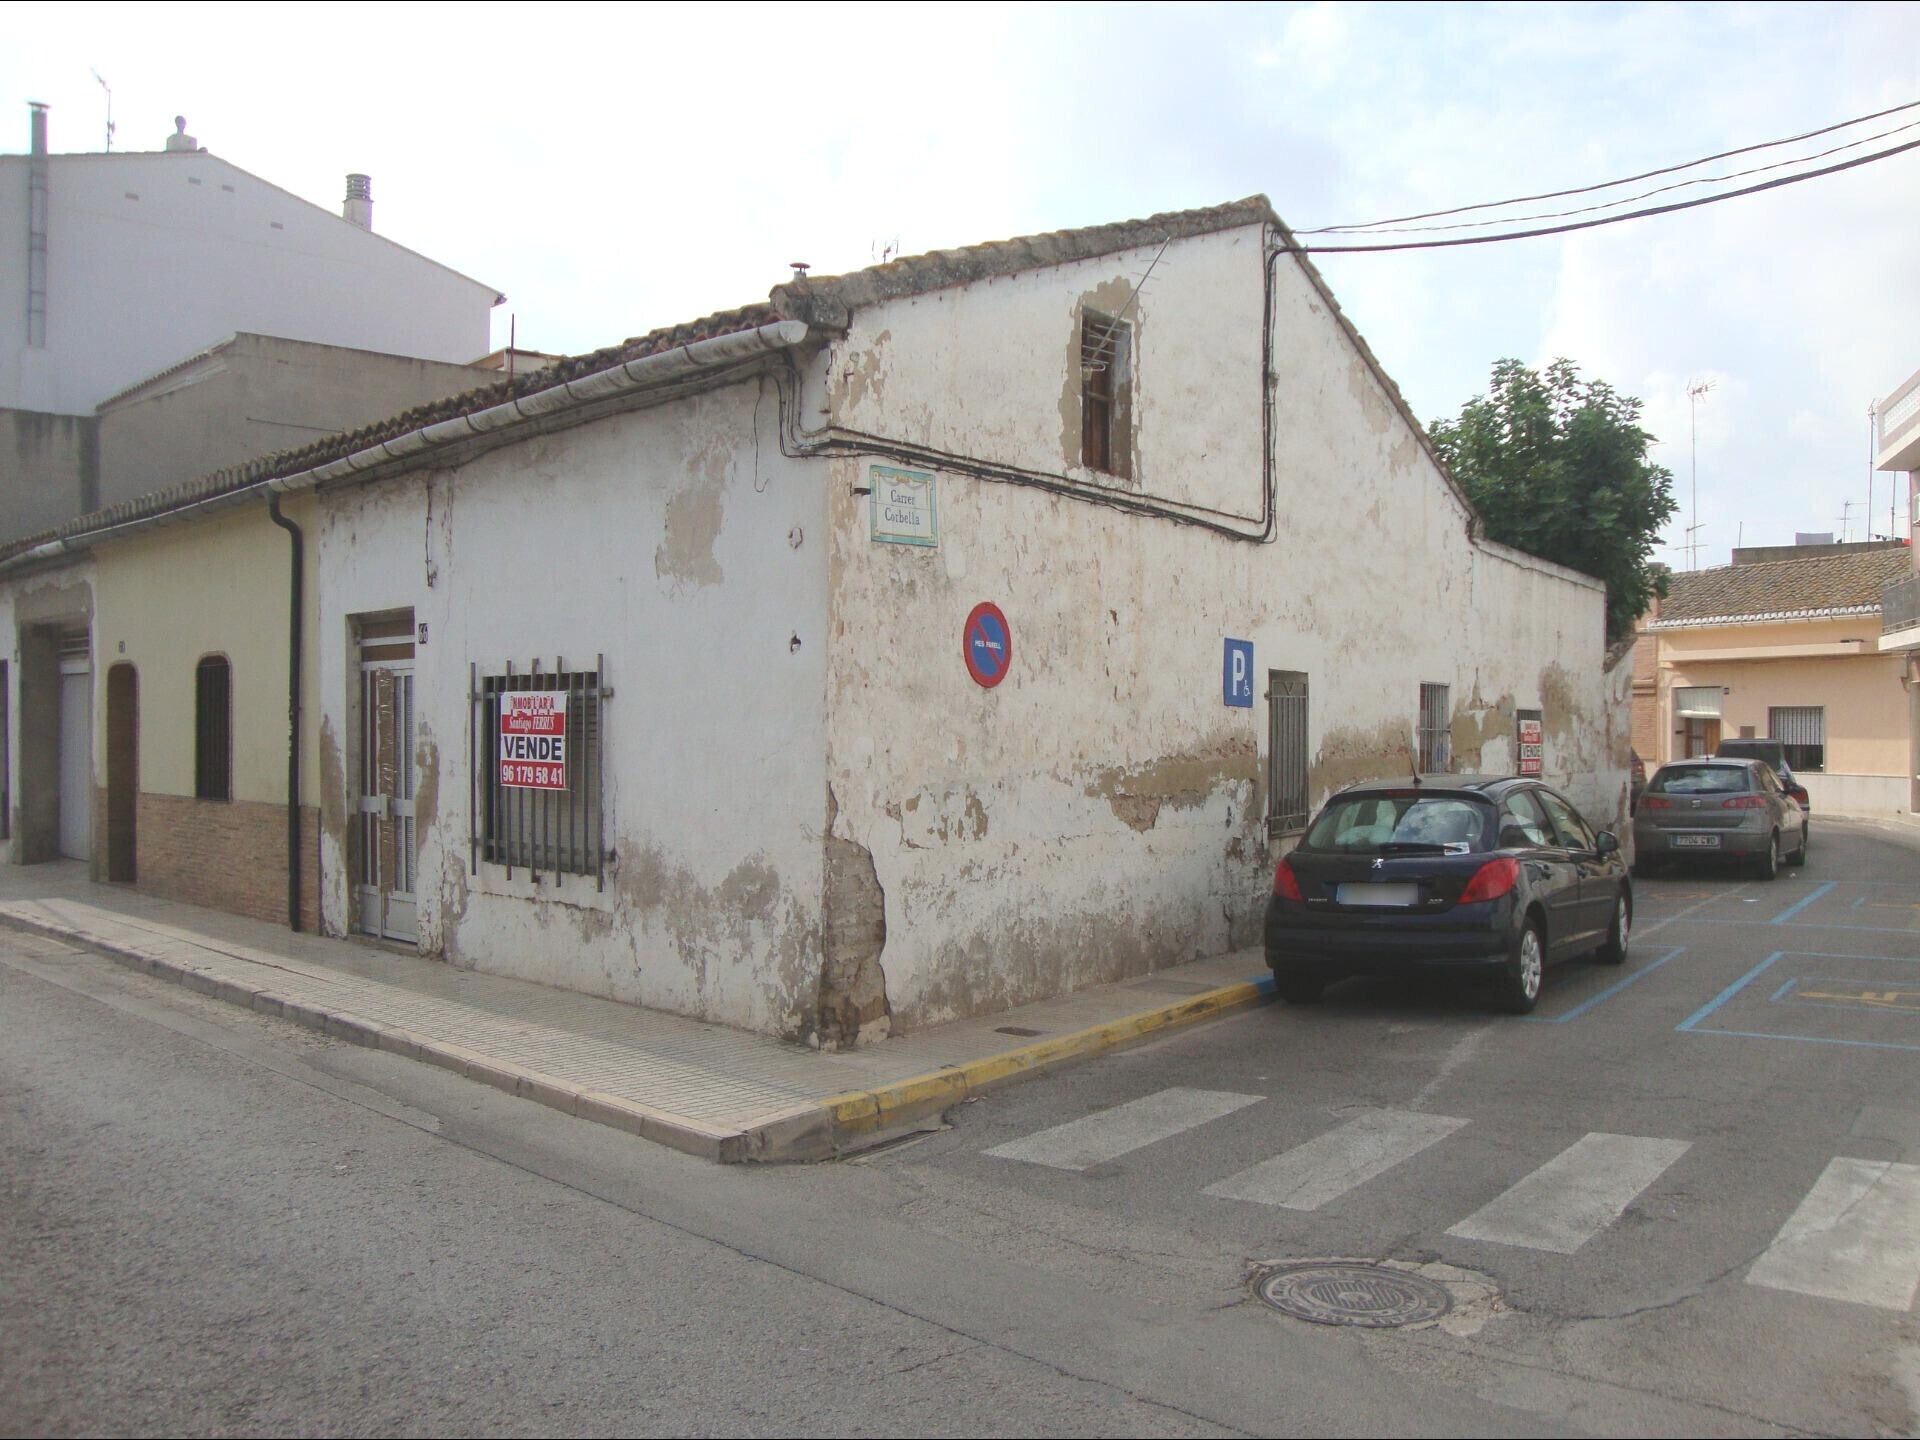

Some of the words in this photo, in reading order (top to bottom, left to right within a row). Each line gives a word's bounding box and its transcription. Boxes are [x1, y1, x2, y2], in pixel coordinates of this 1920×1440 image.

[890, 489, 915, 505] Carrer
[884, 507, 920, 526] Corbella
[1232, 649, 1245, 696] P
[509, 716, 532, 733] Santiago
[503, 735, 562, 761] VENDE
[503, 765, 514, 782] 96
[516, 766, 534, 783] 179
[535, 768, 549, 784] 58
[550, 768, 563, 785] 41
